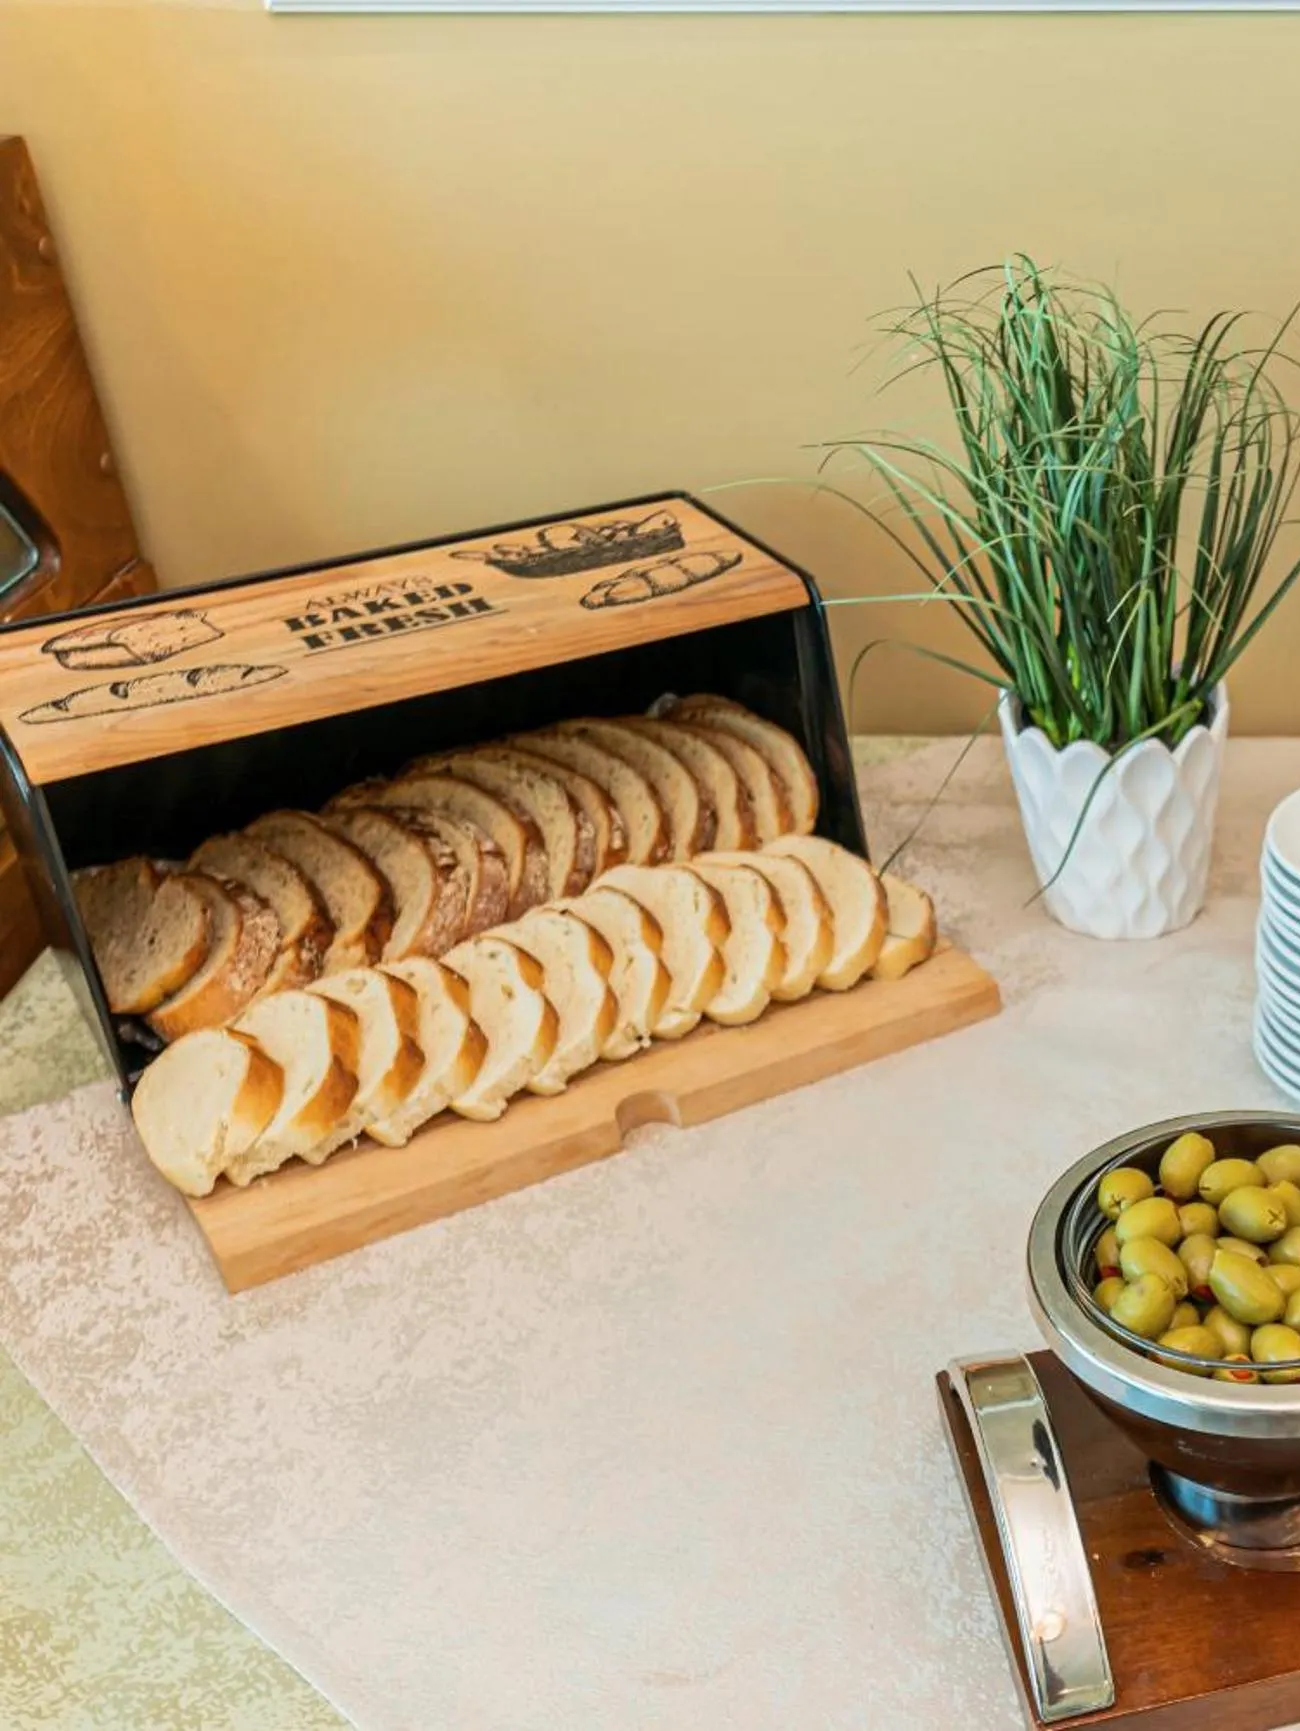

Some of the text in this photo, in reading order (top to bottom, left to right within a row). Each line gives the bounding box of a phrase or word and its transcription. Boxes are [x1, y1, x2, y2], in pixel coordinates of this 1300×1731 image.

[284, 583, 474, 632] BAKED
[305, 576, 432, 610] ALWAYS
[301, 597, 493, 649] FRESH
